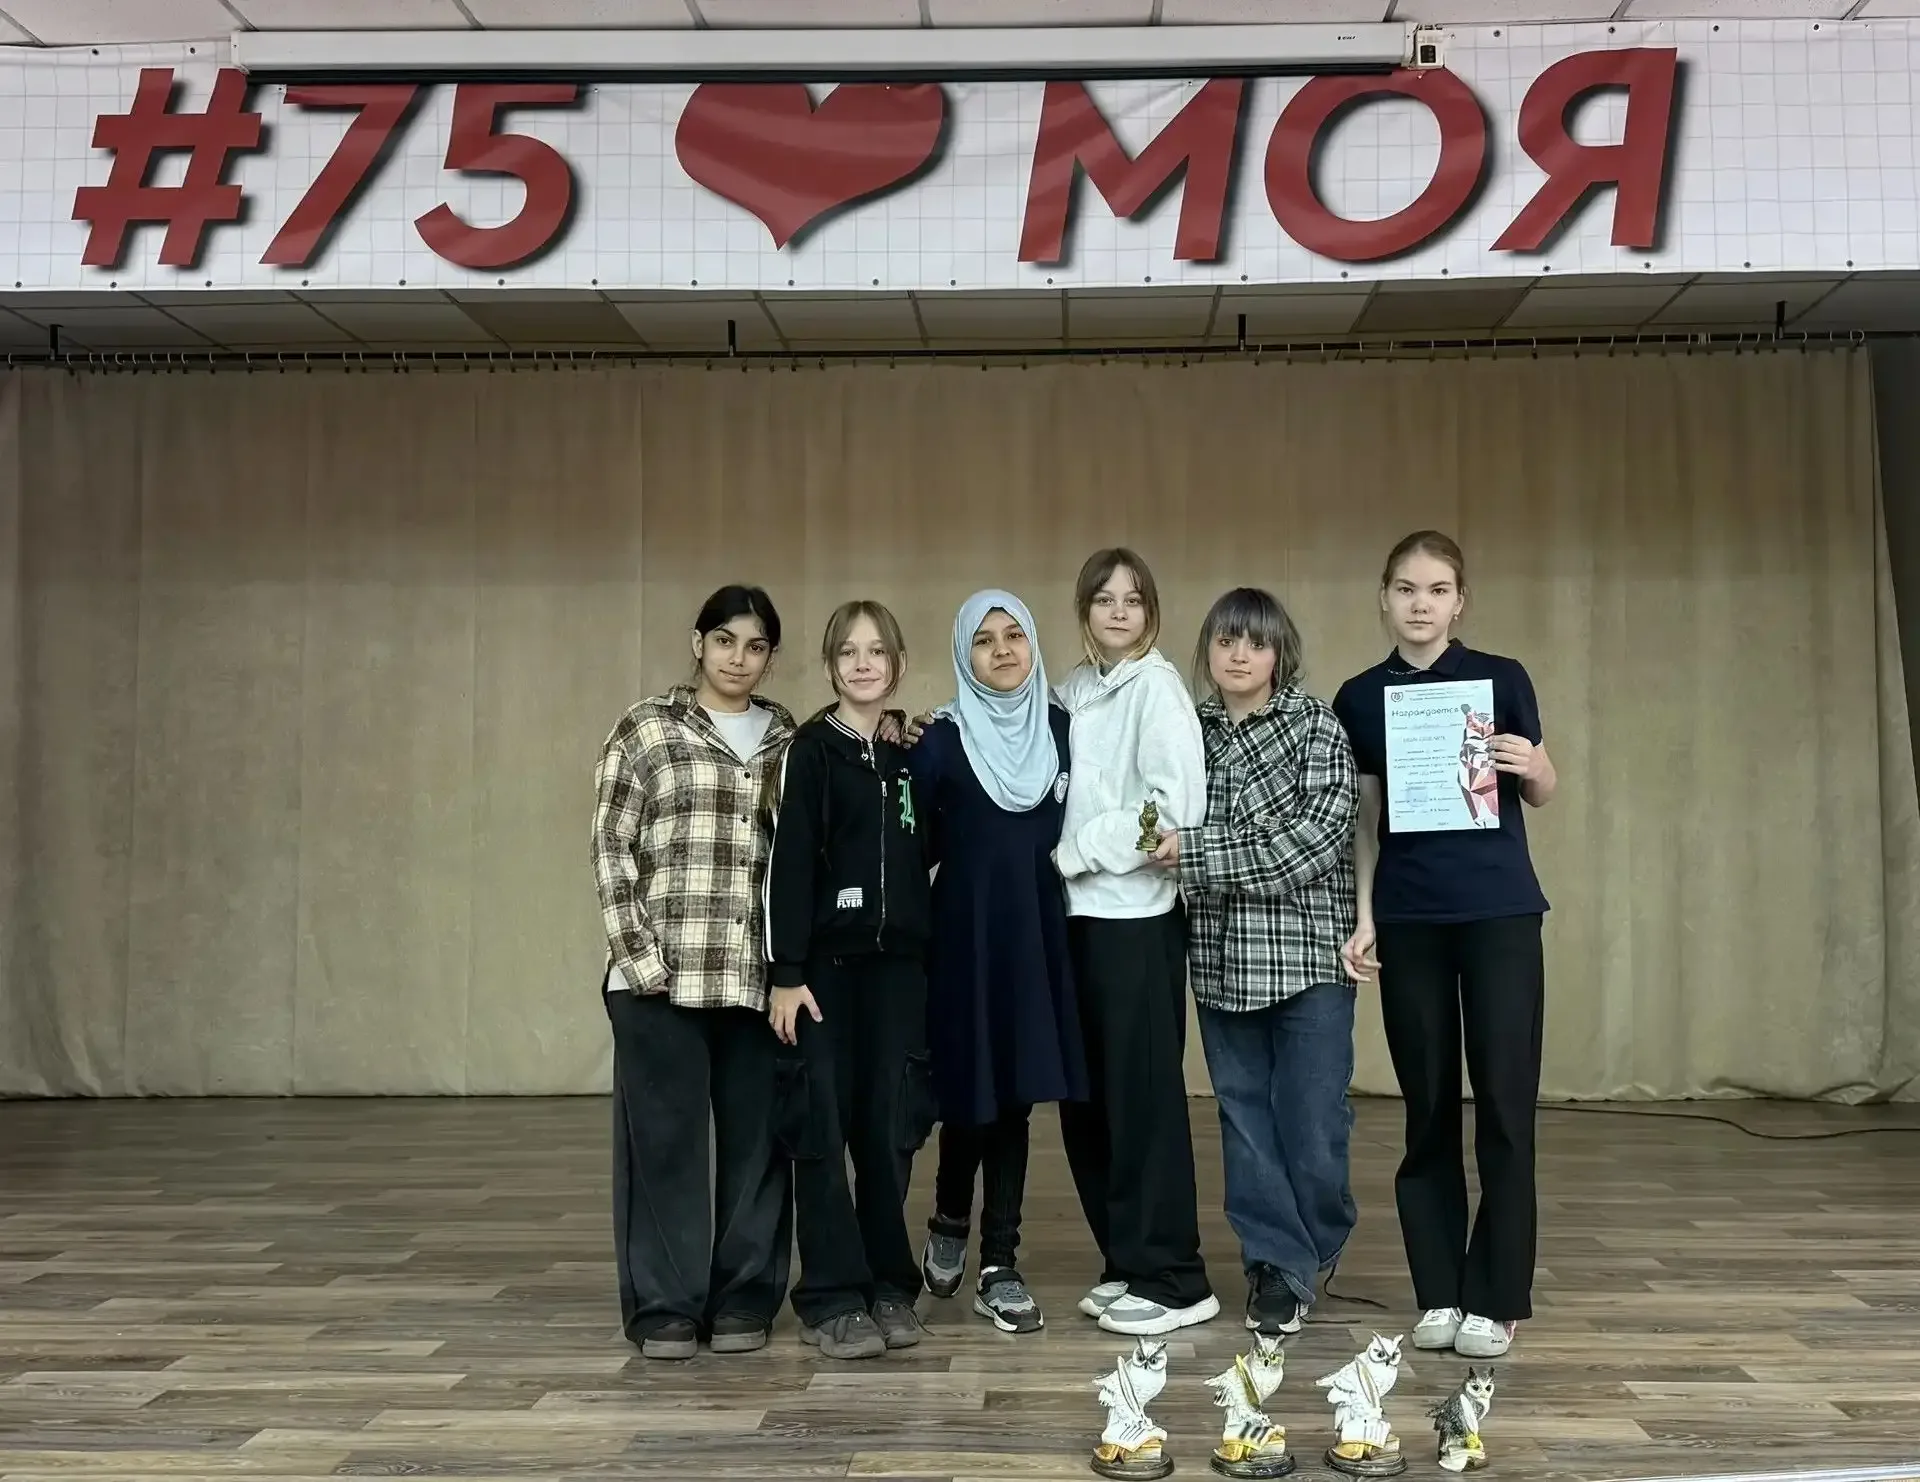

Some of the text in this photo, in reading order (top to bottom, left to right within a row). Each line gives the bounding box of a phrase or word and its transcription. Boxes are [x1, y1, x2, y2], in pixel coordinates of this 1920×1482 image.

[73, 48, 1678, 267] #75 МОЯ
[836, 898, 863, 909] FLYER
